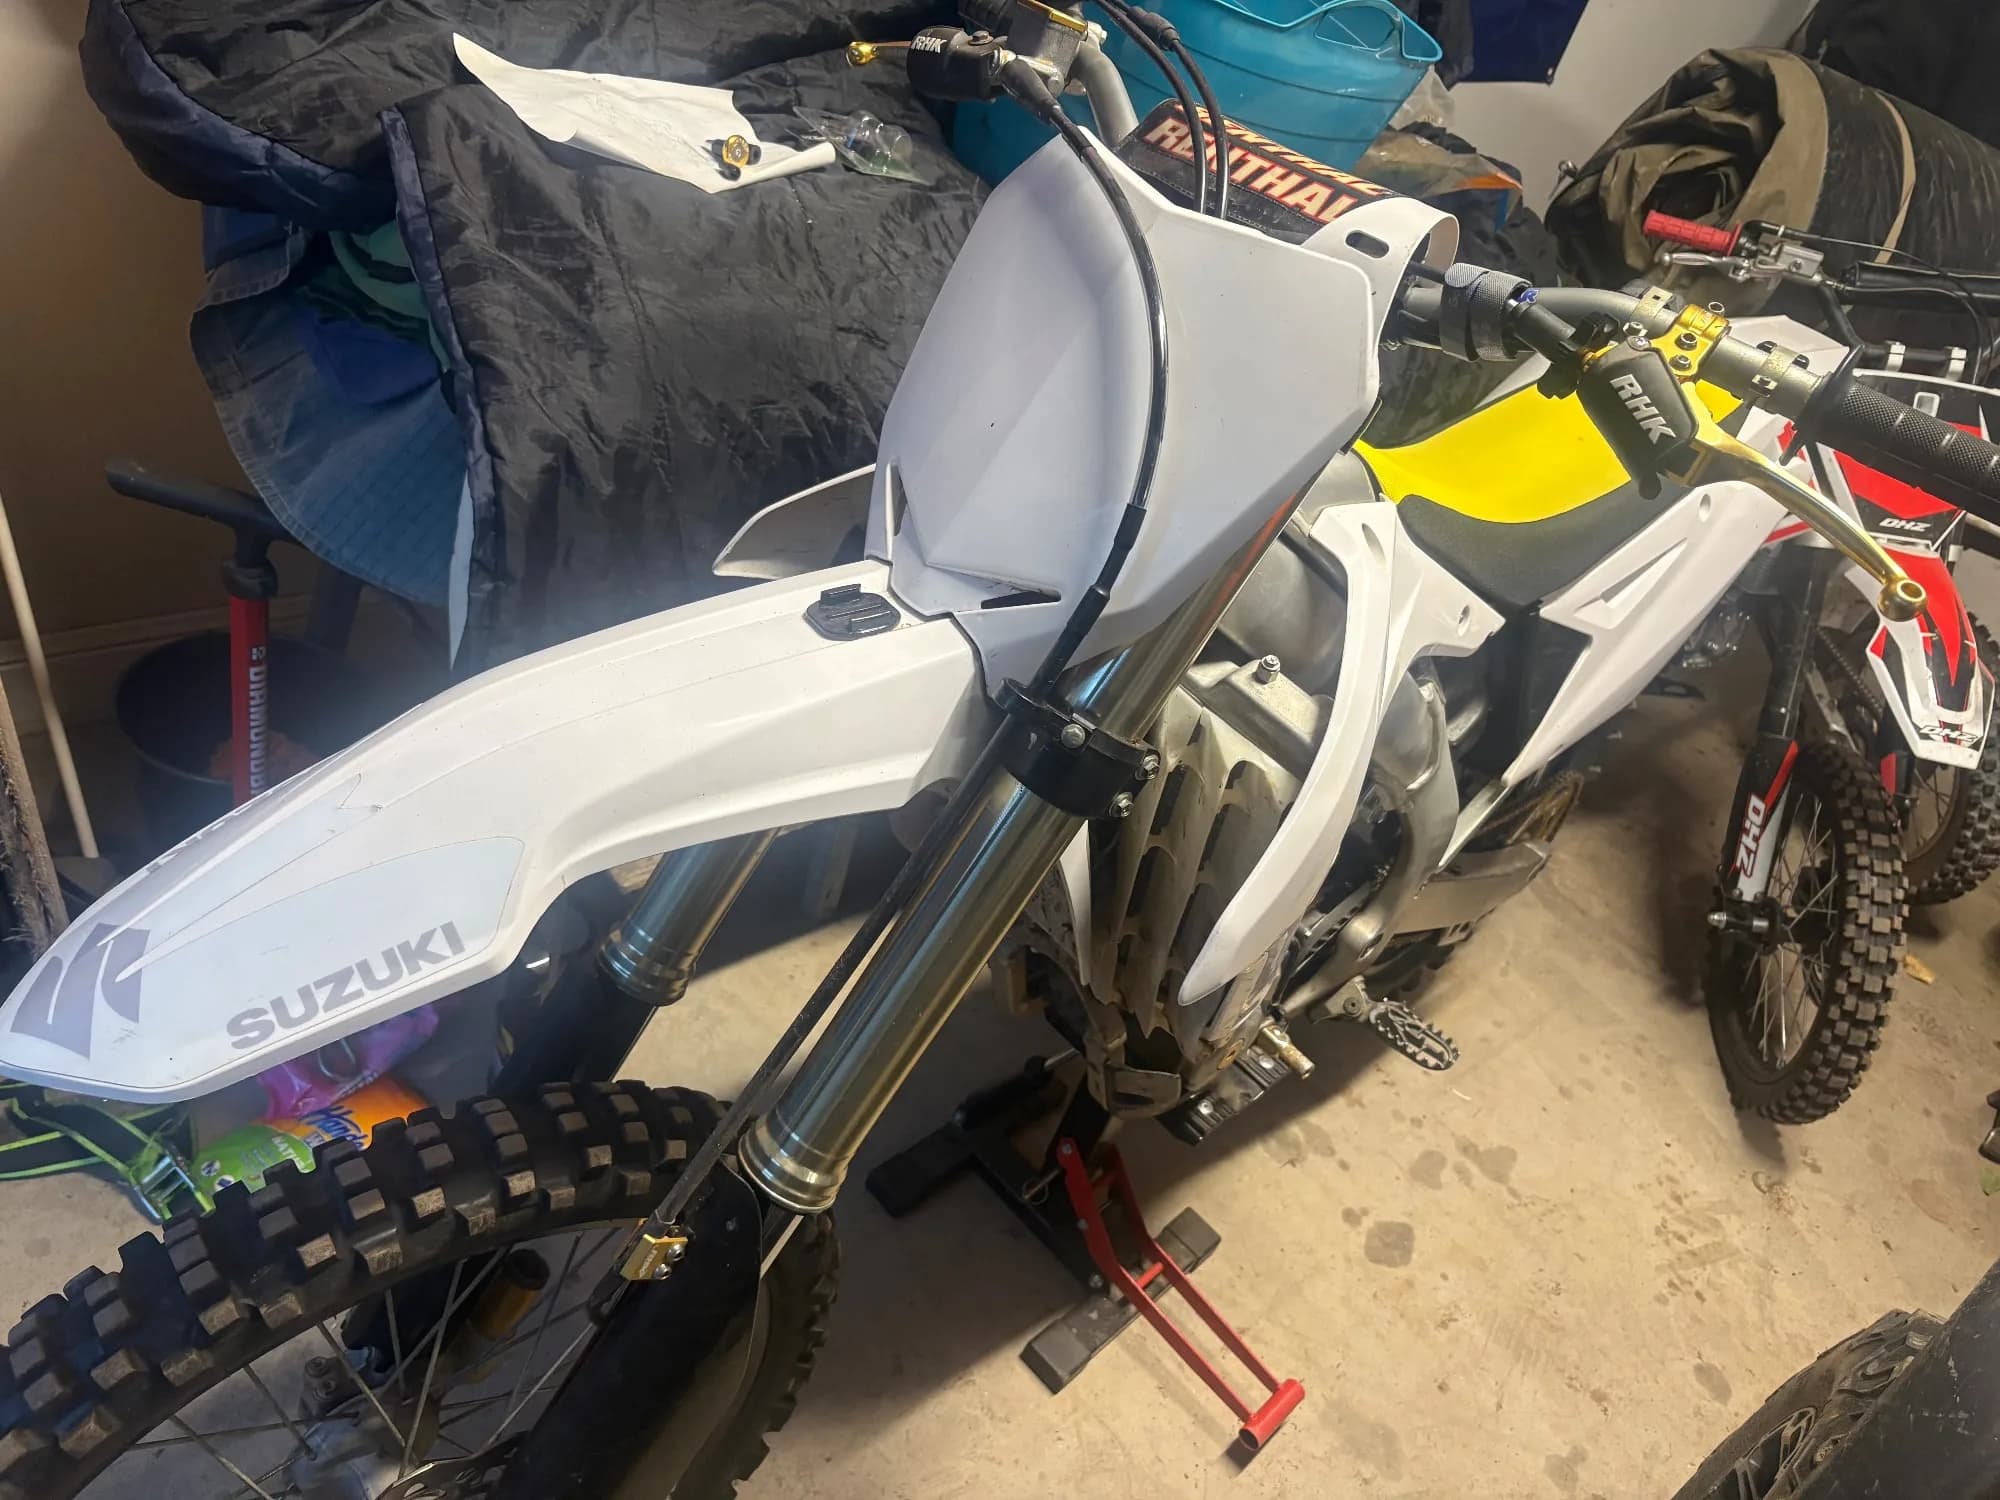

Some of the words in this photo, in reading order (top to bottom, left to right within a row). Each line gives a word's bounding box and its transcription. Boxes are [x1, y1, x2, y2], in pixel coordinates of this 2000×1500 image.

[911, 36, 947, 53] RHK
[1609, 373, 1677, 445] RHK
[1879, 518, 1931, 532] DHZ
[1919, 725, 1978, 743] DHZ
[1736, 793, 1766, 876] DHZ
[226, 920, 466, 1050] SUZUKI
